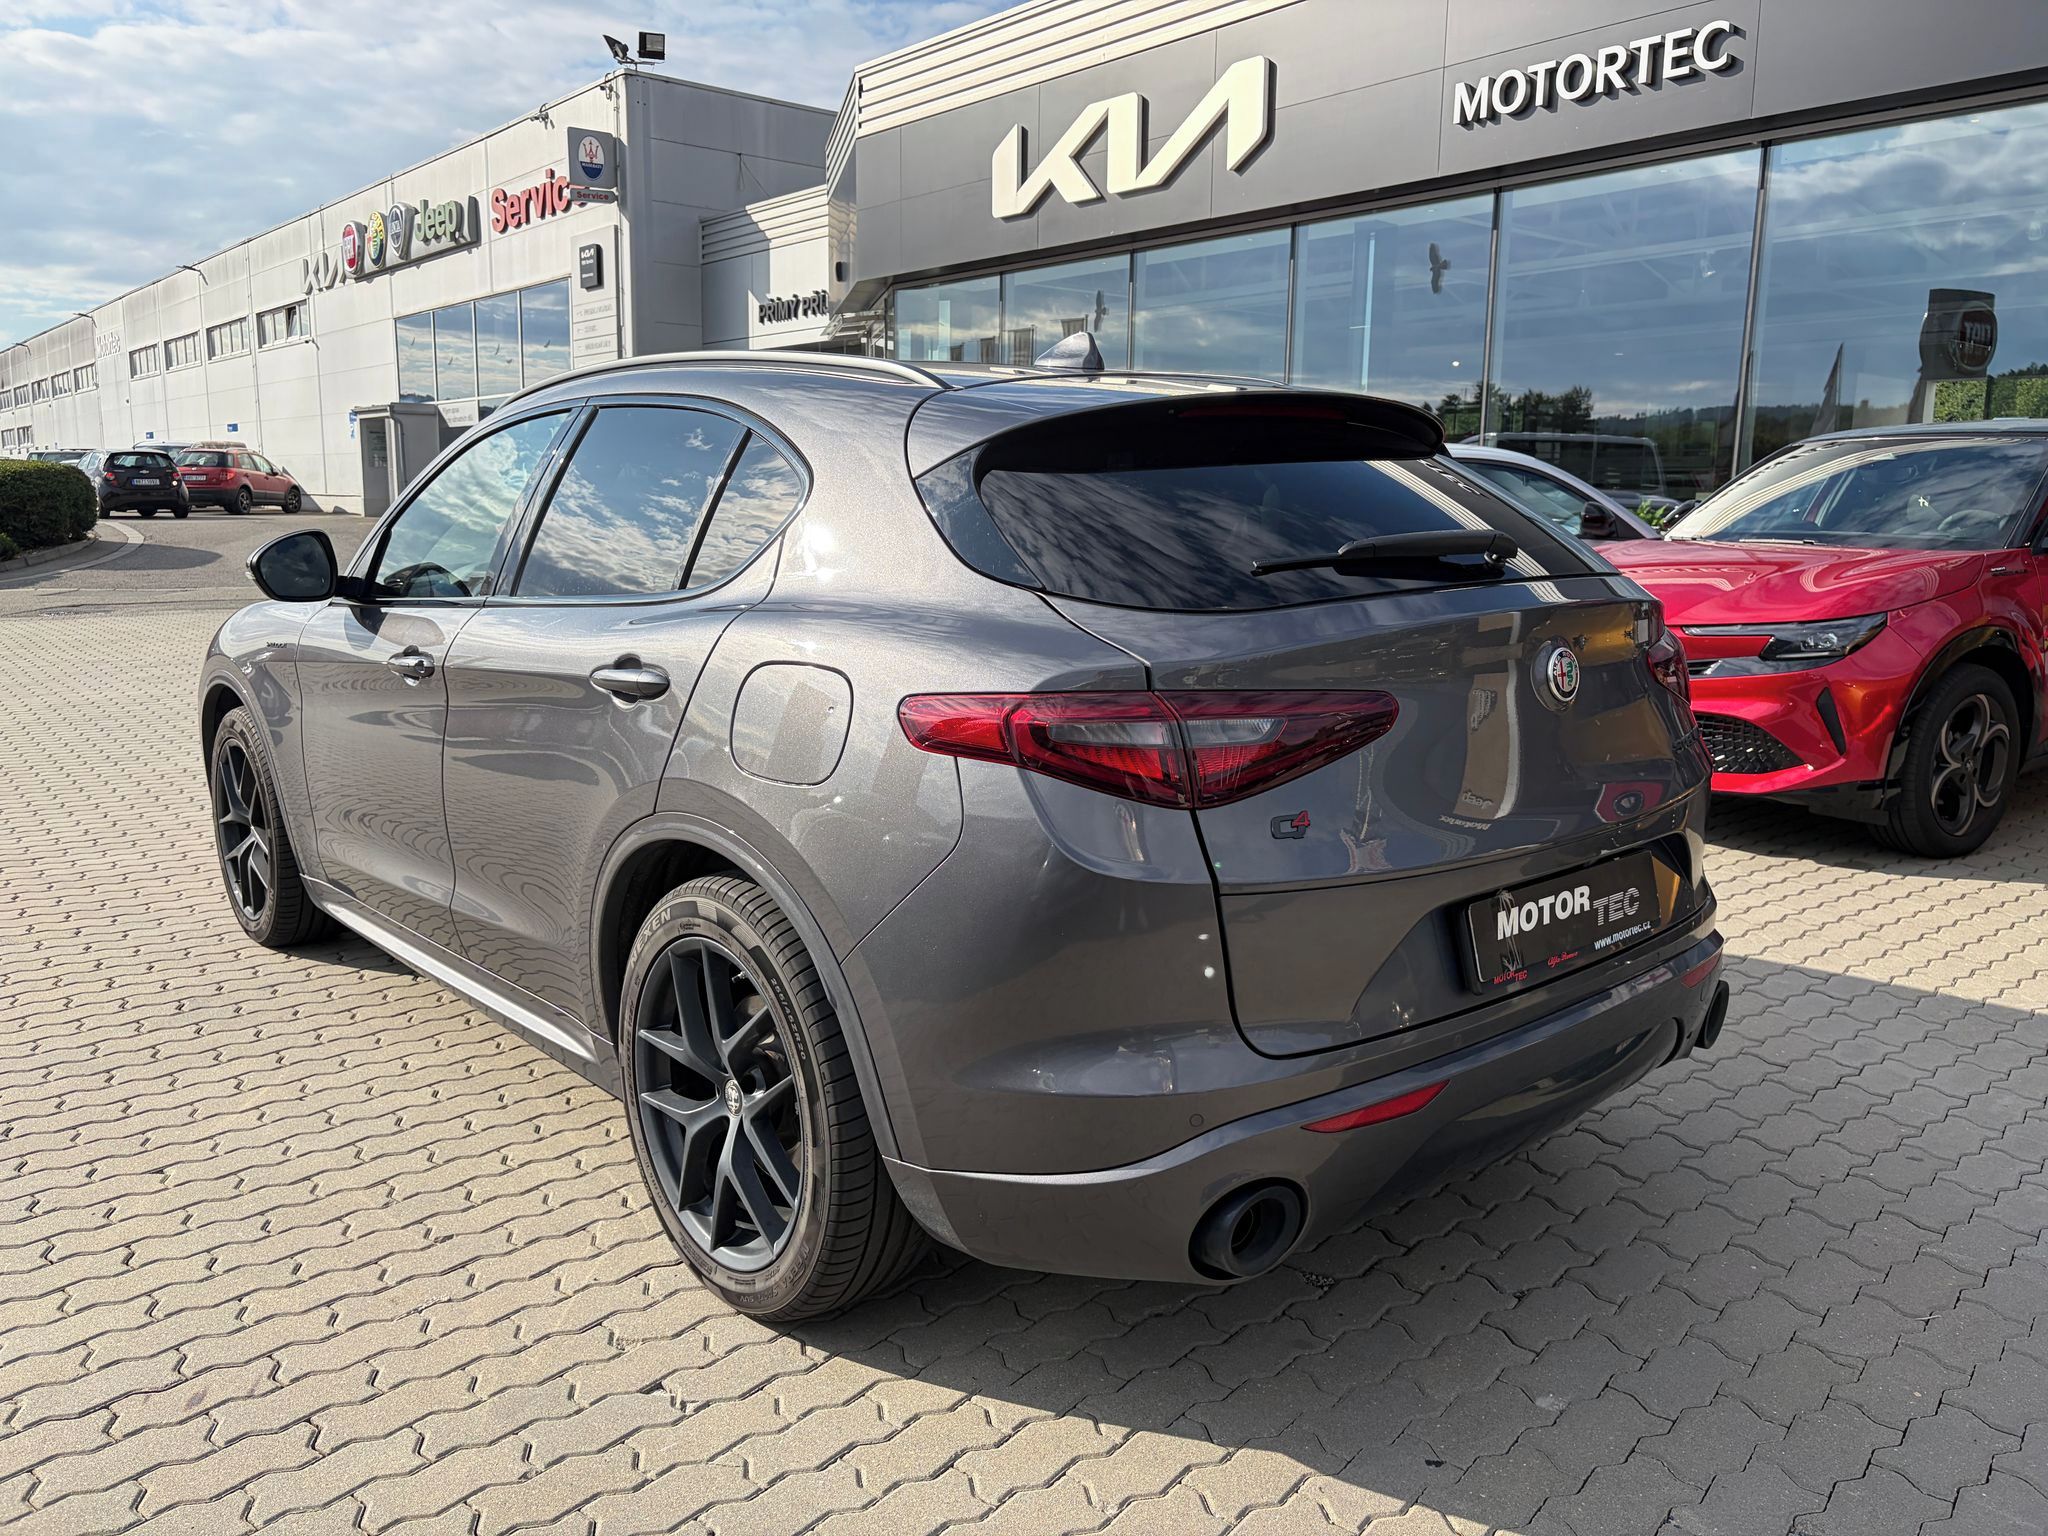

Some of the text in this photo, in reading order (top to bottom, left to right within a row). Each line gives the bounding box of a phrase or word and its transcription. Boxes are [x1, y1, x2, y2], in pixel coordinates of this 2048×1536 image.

[1453, 19, 1732, 125] MOTORTEC
[991, 55, 1270, 218] KIA
[415, 199, 459, 241] Jeep
[491, 168, 587, 233] Servic
[576, 191, 609, 200] Service
[1271, 810, 1310, 839] Q4
[629, 908, 671, 969] NEXEN
[1497, 885, 1639, 940] MOTOR TEC
[1593, 921, 1652, 950] www.motortec.cz
